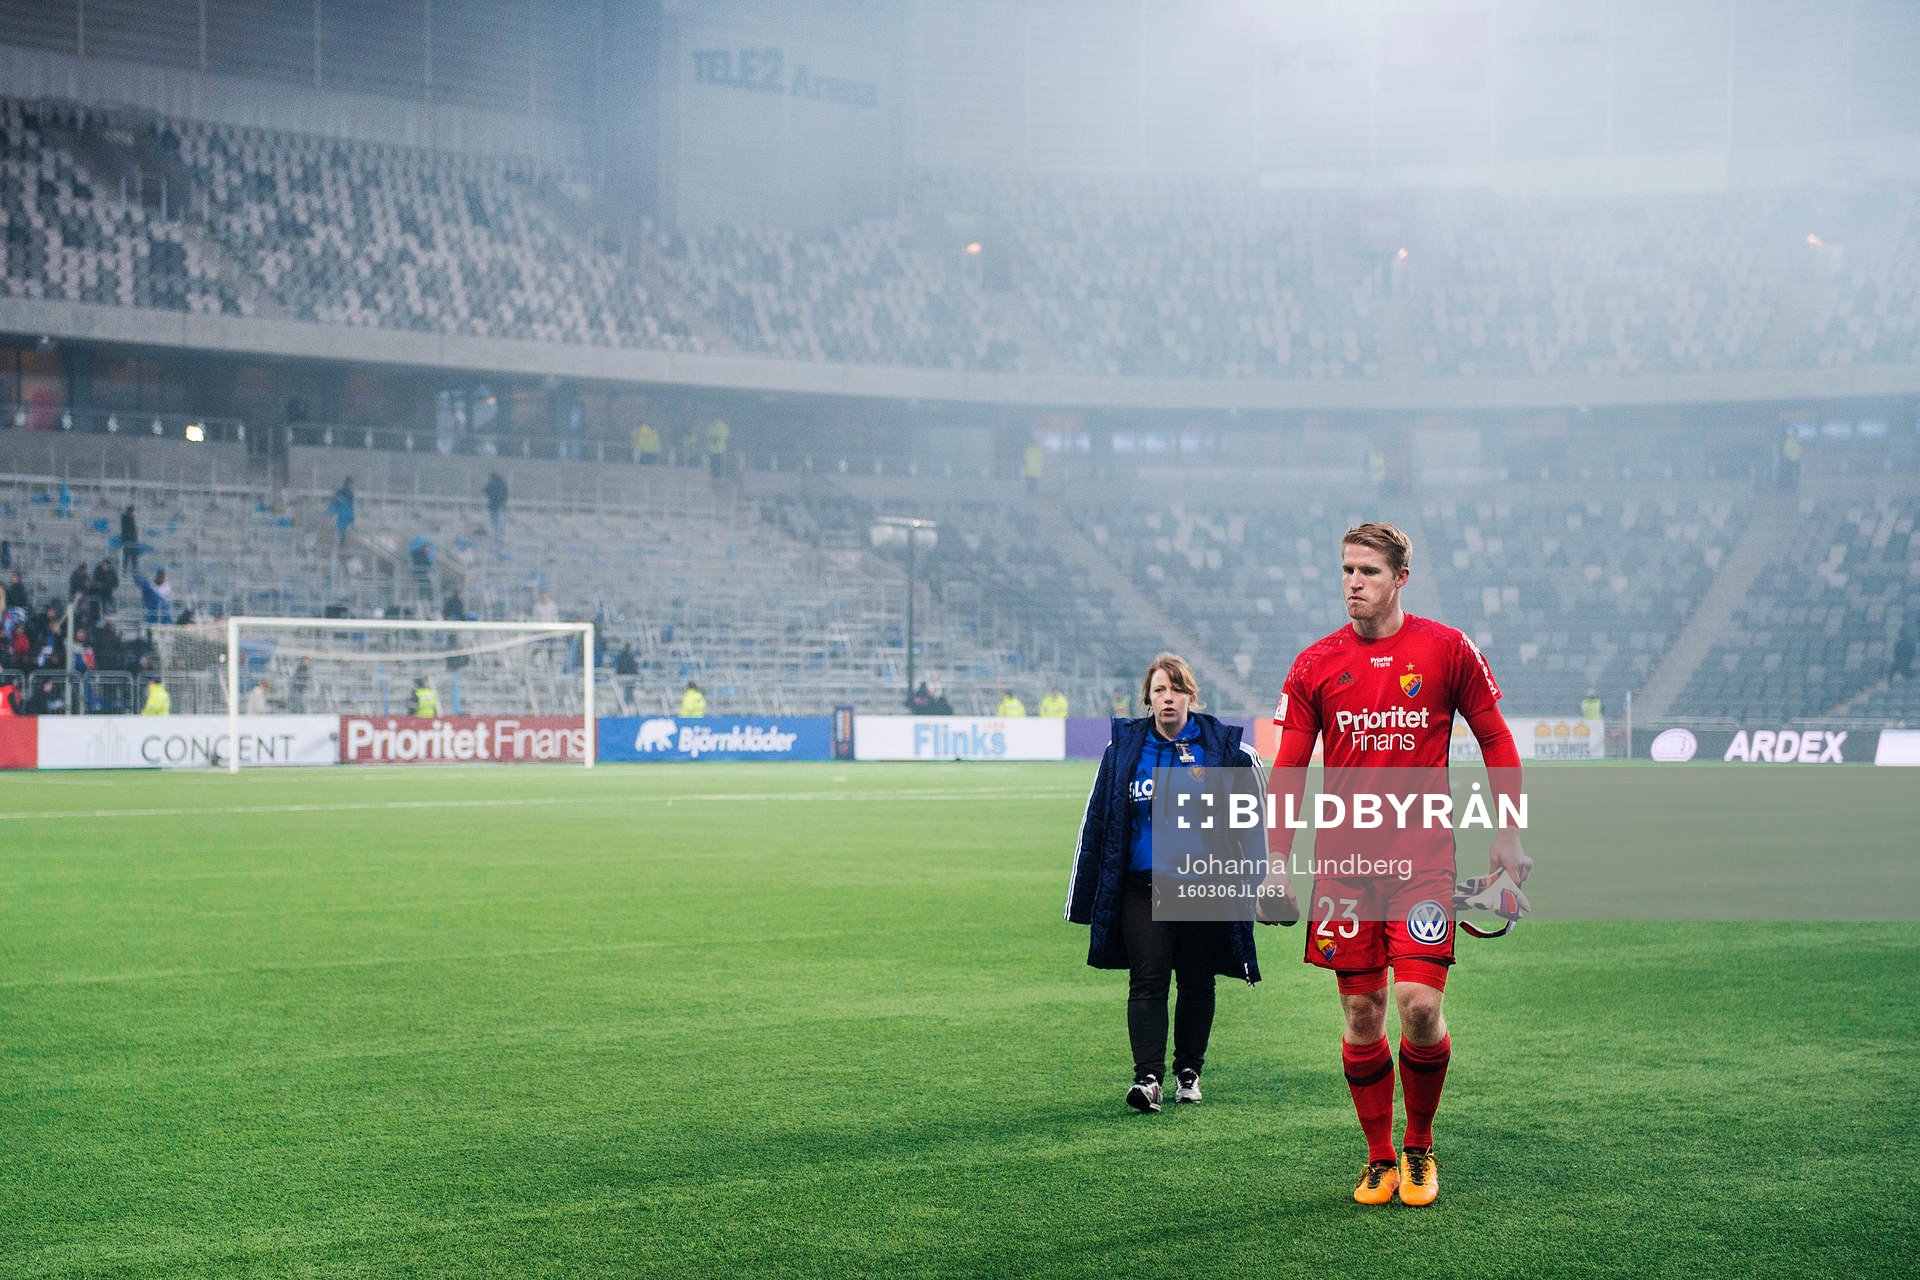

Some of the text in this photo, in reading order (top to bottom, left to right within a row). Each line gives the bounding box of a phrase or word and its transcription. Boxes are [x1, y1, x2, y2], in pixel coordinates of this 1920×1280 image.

[691, 47, 785, 94] TELE2
[1336, 706, 1429, 733] Prioritet
[347, 720, 586, 760] Prioritet Finans
[913, 723, 1008, 756] Flinks
[1352, 731, 1415, 751] Finans
[1723, 729, 1848, 763] ARDEX
[1316, 896, 1359, 939] 23
